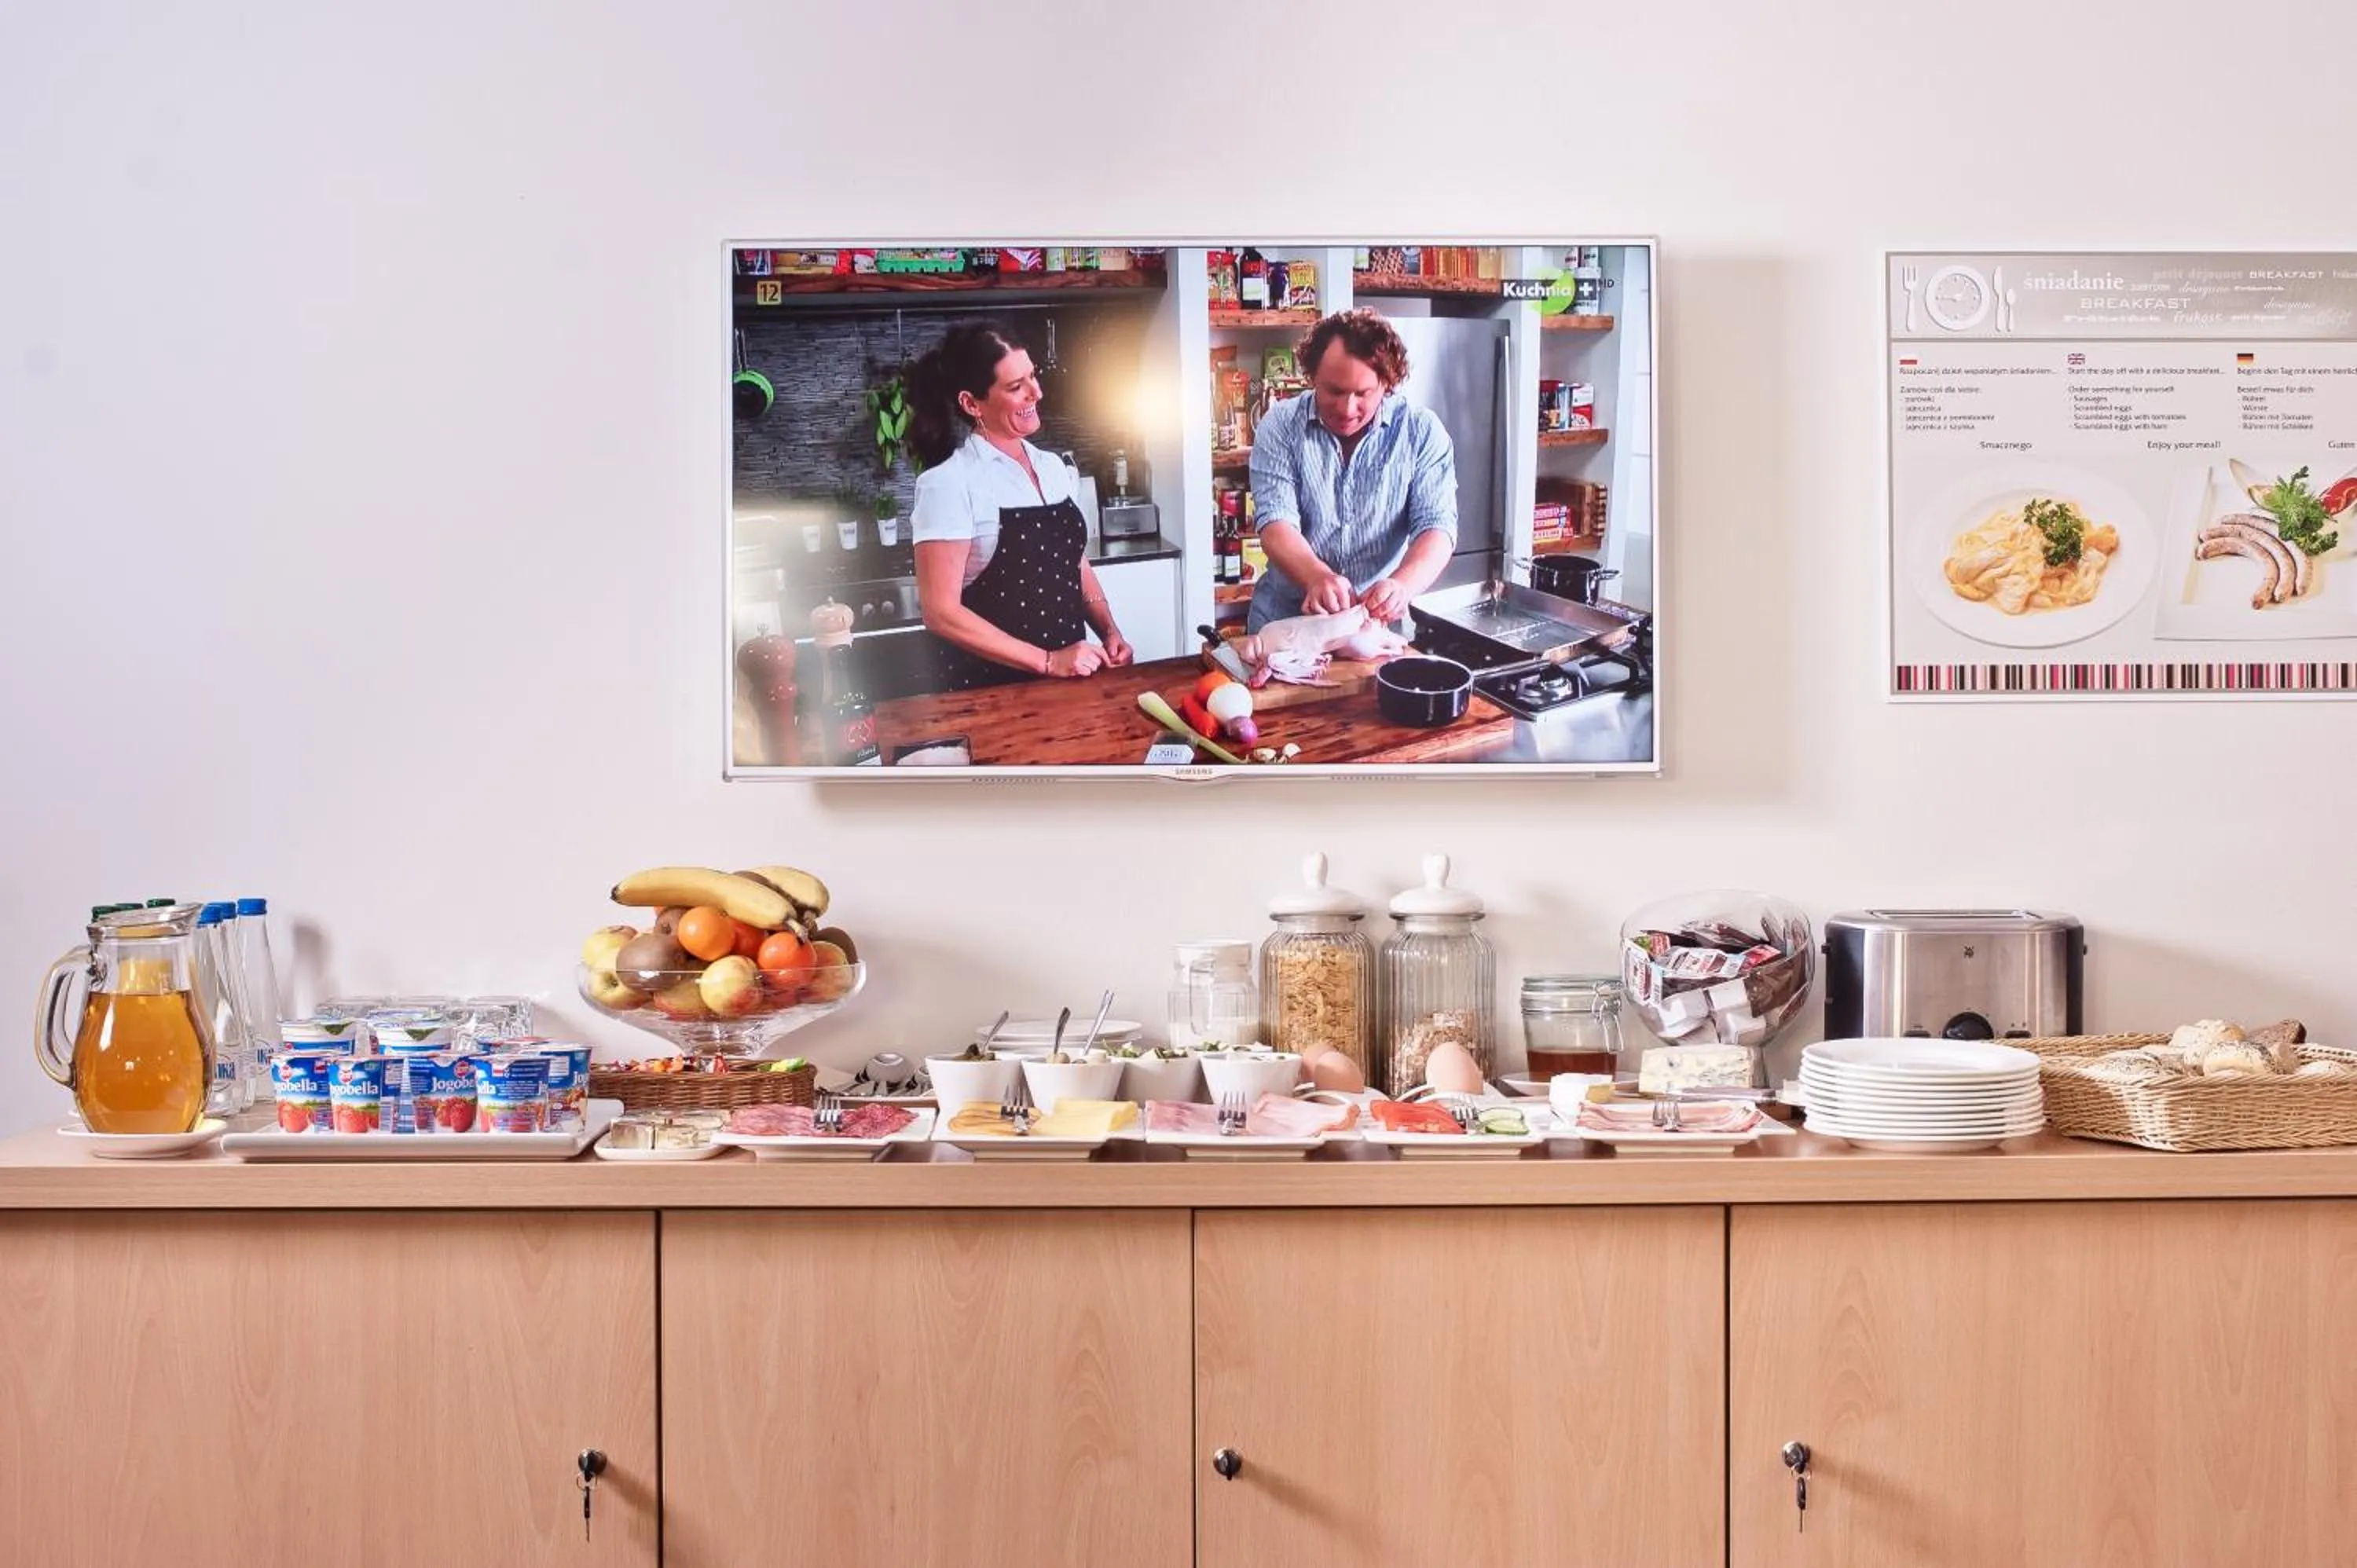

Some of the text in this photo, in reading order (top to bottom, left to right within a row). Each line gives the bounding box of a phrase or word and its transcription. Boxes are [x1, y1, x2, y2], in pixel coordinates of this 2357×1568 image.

[2022, 269, 2124, 291] śniadanie
[2249, 270, 2324, 279] BREAKFAST
[760, 284, 779, 302] 12
[1502, 282, 1572, 298] Kuchnia
[2080, 297, 2191, 310] BREAKFAST
[2100, 367, 2114, 376] day
[1979, 441, 2033, 452] Smacznego
[2147, 440, 2221, 451] Enjoy your meal!
[2327, 441, 2355, 449] Guten
[1175, 767, 1214, 775] SAMSUNG
